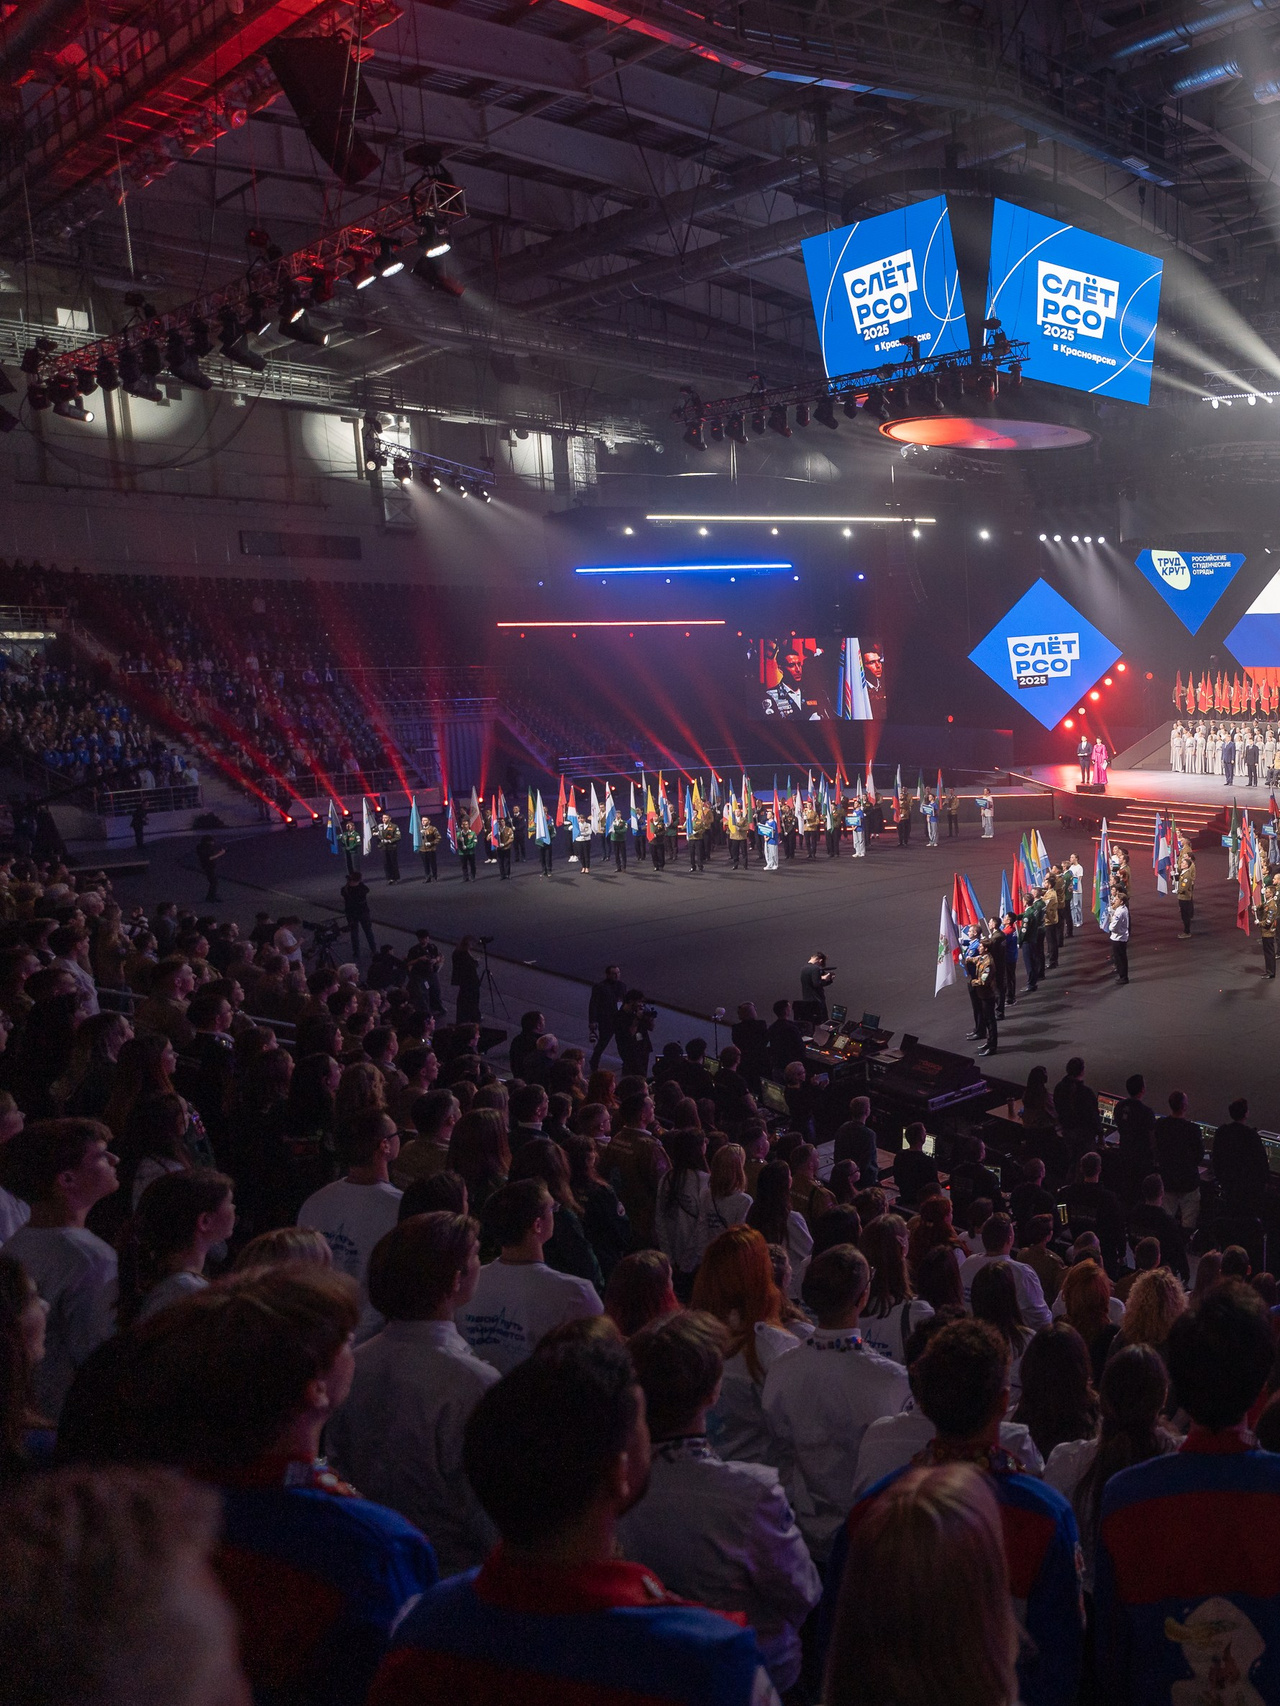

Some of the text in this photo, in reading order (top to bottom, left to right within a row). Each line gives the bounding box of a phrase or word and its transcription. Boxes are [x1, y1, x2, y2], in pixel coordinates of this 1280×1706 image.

[850, 259, 912, 299] СЛЁТ
[1042, 273, 1116, 309] СЛЁТ
[856, 292, 908, 320] РСО
[1043, 299, 1102, 331] РСО
[863, 323, 890, 341] 2025
[1043, 324, 1075, 341] 2025
[874, 332, 932, 352] в Красске
[1053, 343, 1117, 366] в Красноярске
[1157, 557, 1182, 567] ТРУД
[1191, 554, 1227, 562] РОССИЙСКИЕ
[1192, 561, 1232, 569] СТУДЕНЧЕСКИЕ
[1162, 566, 1186, 576] КРУТ
[1012, 636, 1077, 657] СЛЁТ
[1016, 659, 1069, 675] РСО
[1019, 676, 1047, 686] 2025
